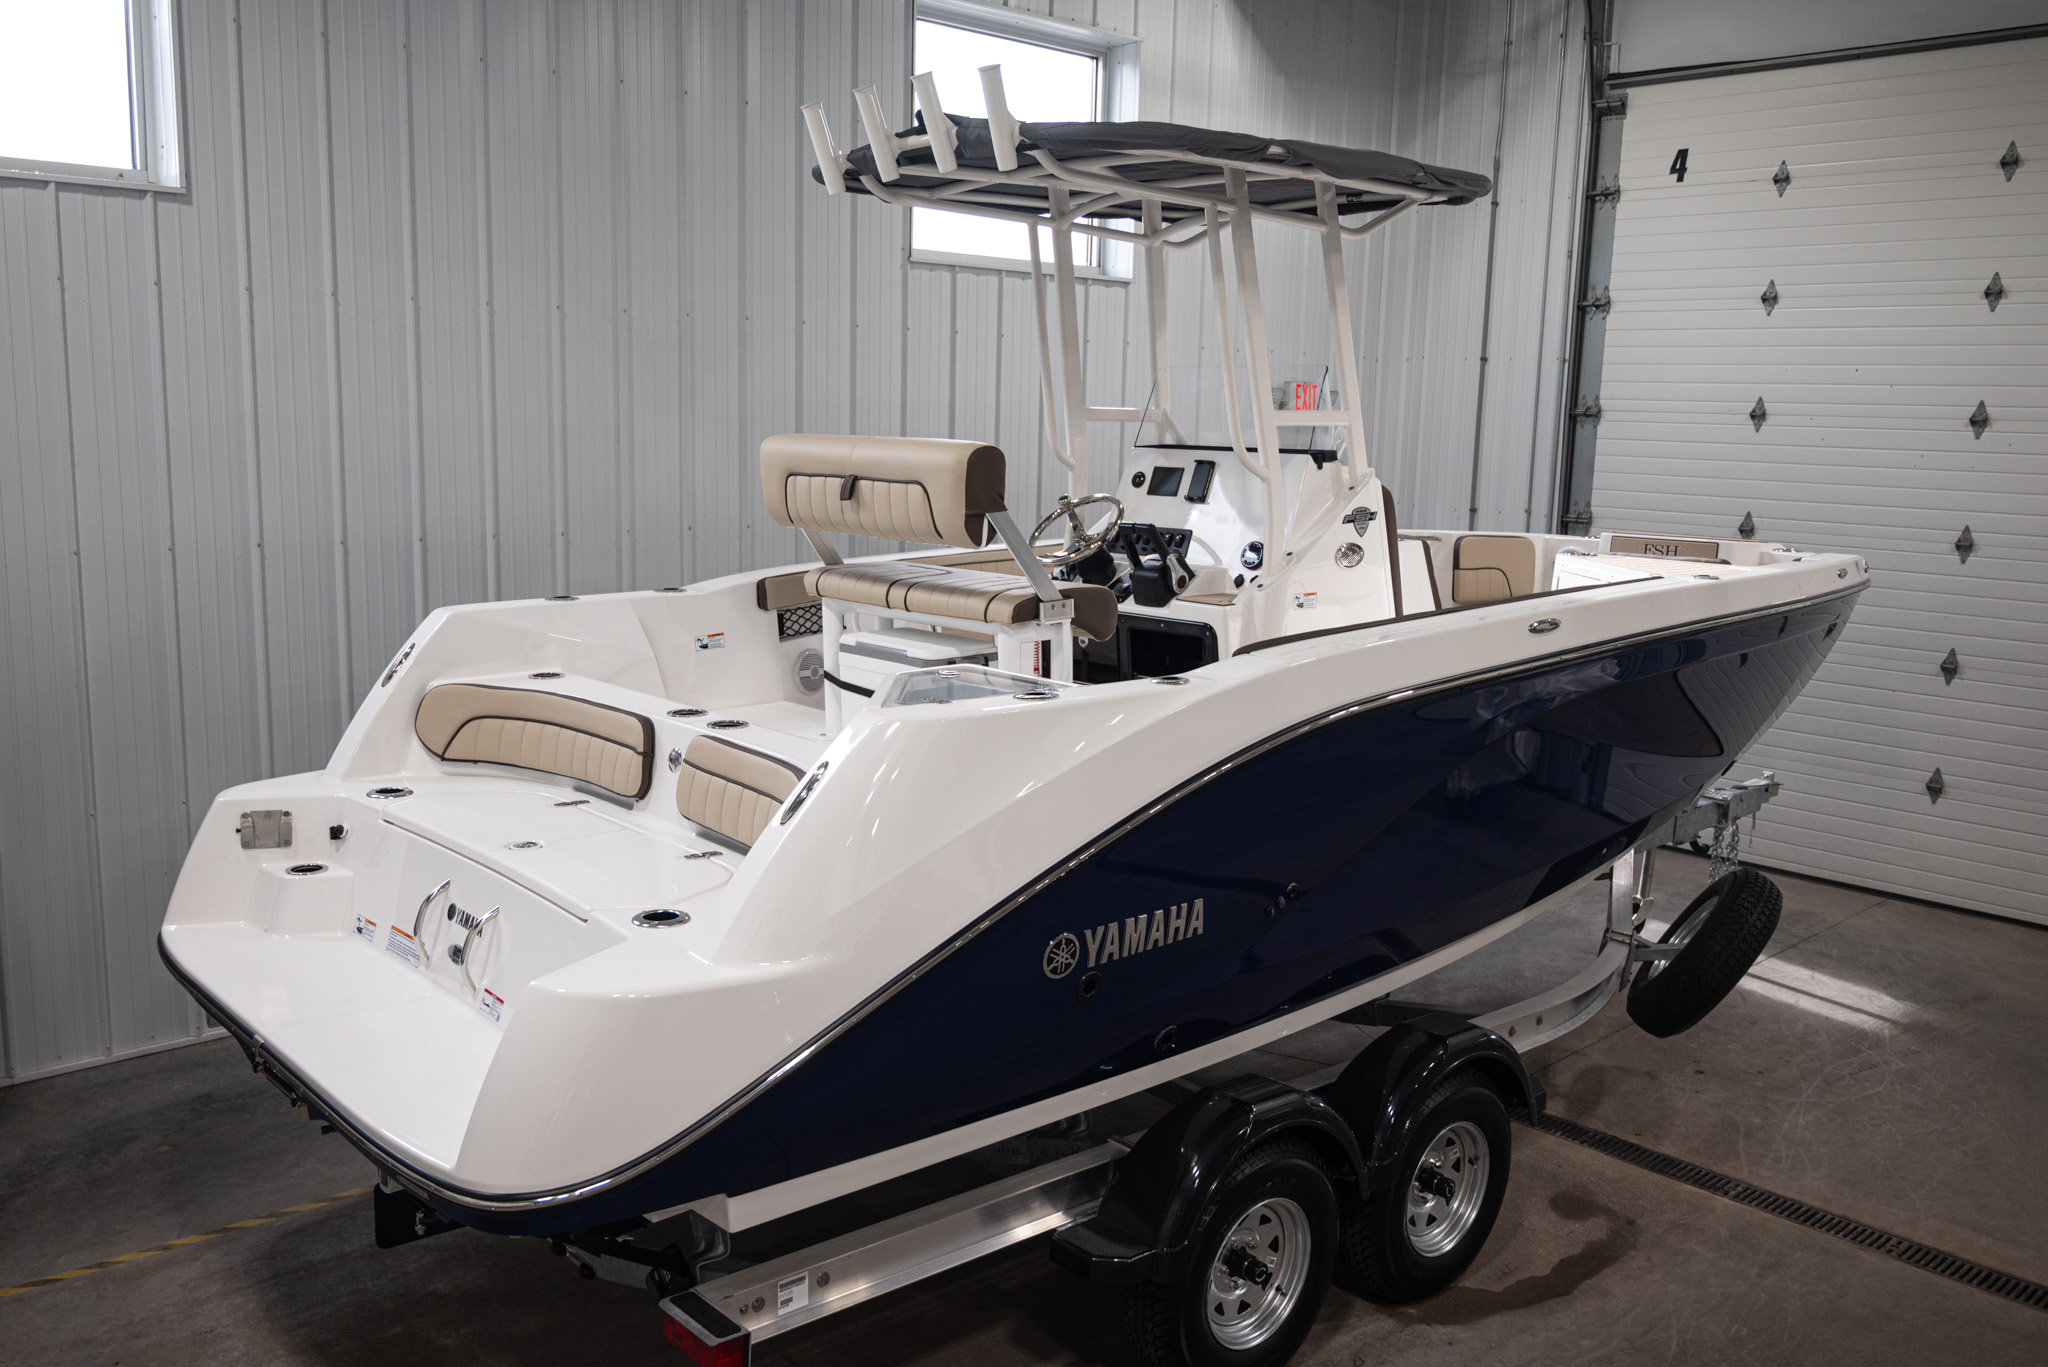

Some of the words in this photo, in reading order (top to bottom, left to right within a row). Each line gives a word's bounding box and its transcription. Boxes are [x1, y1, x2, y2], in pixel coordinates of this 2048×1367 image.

[1669, 148, 1689, 183] 4
[1295, 383, 1318, 411] EXIT
[1643, 543, 1680, 557] FSH
[455, 907, 484, 938] YAMAA
[1083, 898, 1204, 968] YAMAHA
